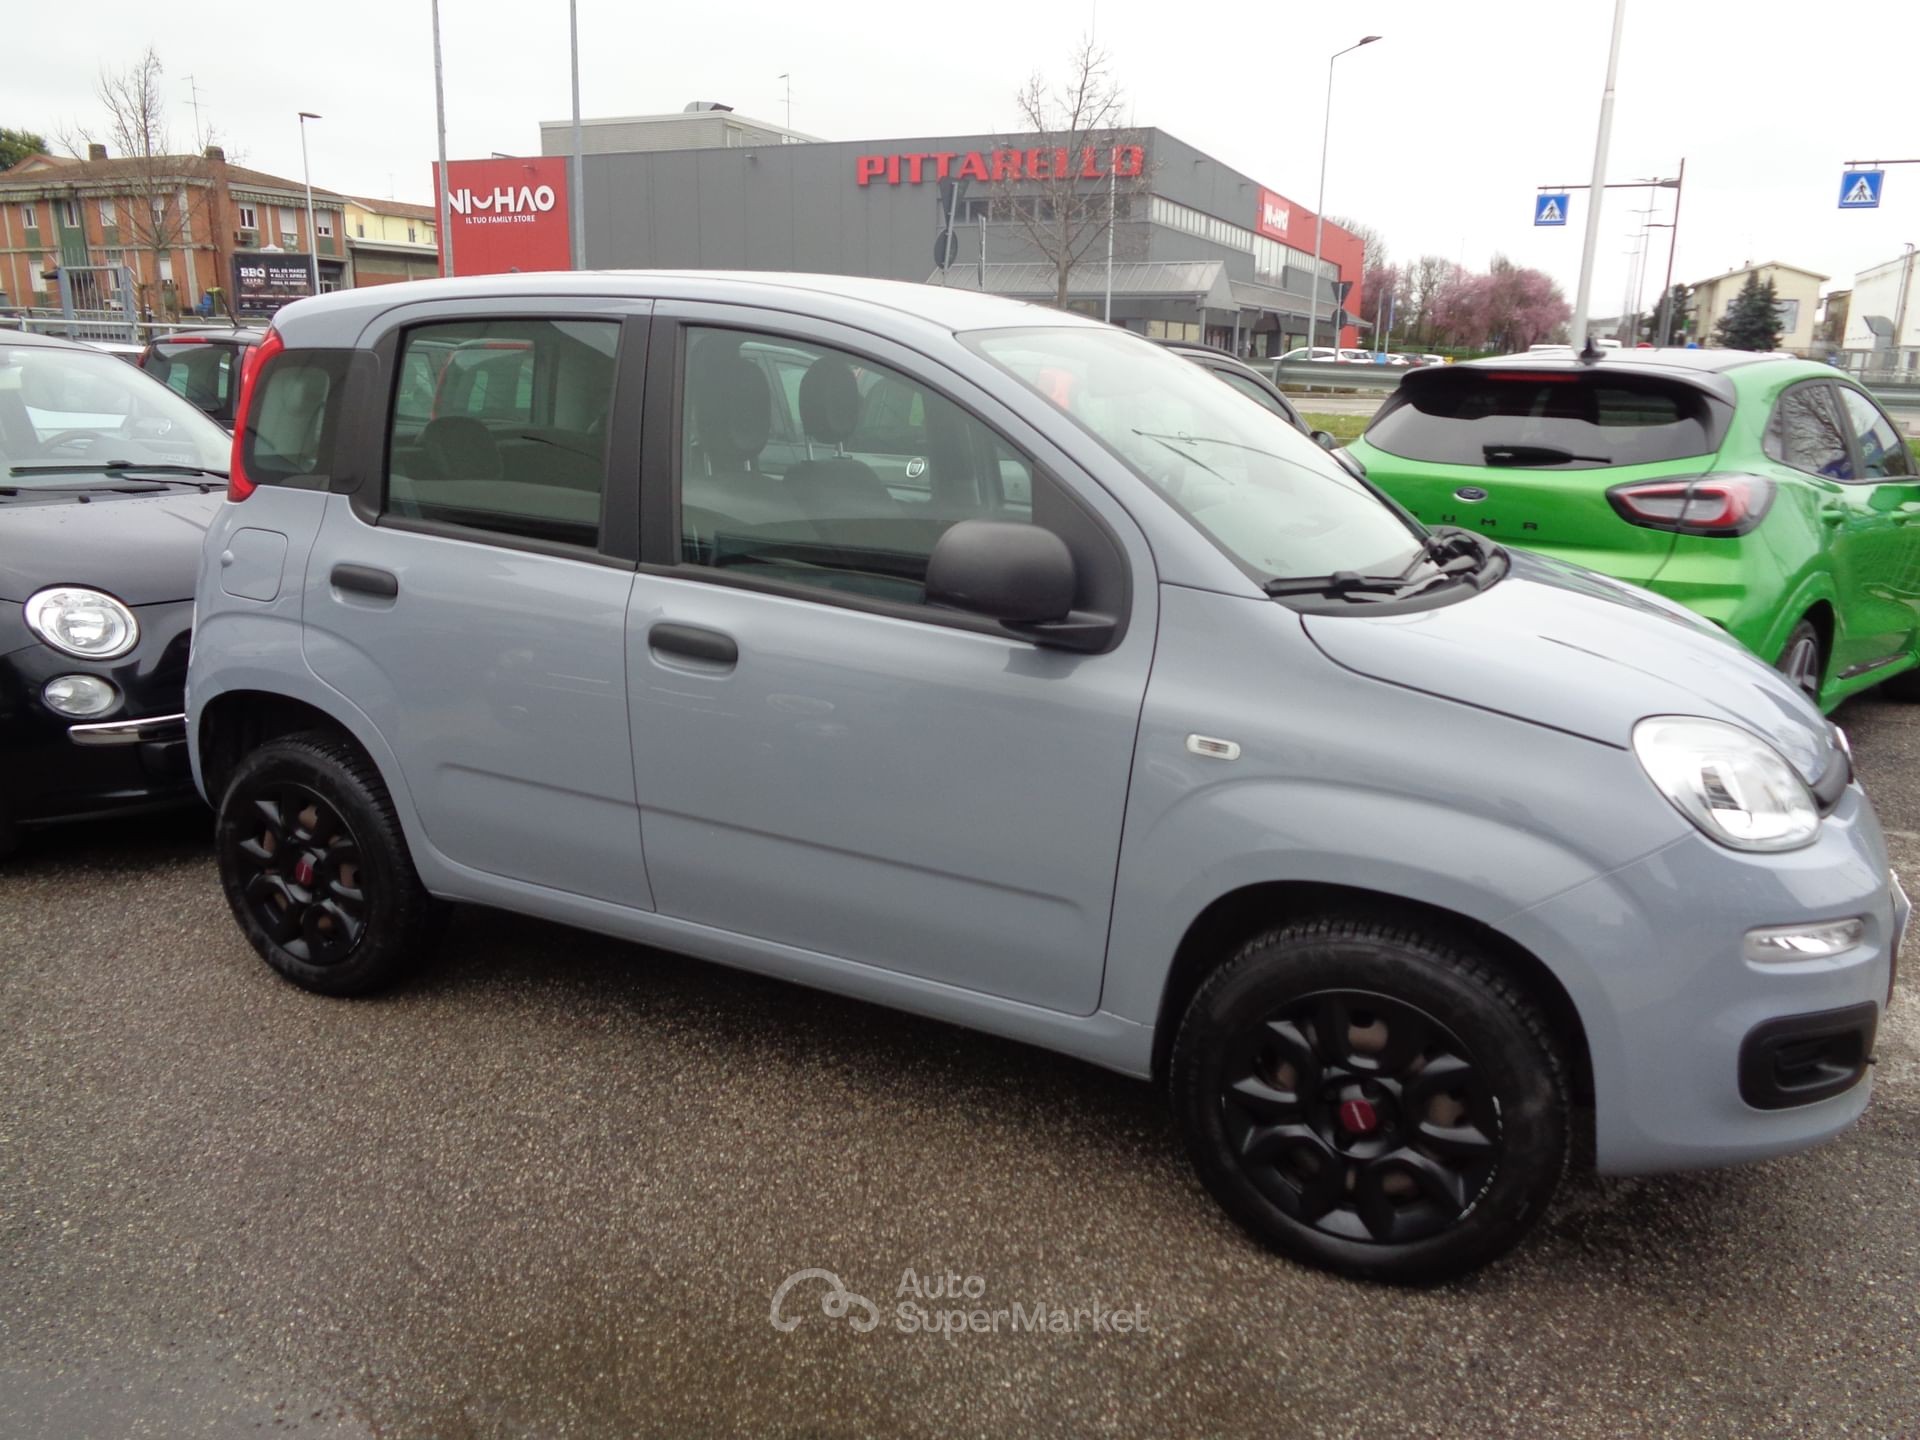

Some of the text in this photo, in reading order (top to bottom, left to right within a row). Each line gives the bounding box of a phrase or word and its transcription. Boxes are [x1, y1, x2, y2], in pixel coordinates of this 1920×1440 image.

[856, 144, 1145, 186] PITTARELLO
[473, 216, 487, 224] TUO
[488, 215, 512, 224] FAMILY
[513, 214, 535, 223] STORE
[240, 267, 266, 277] BBQ
